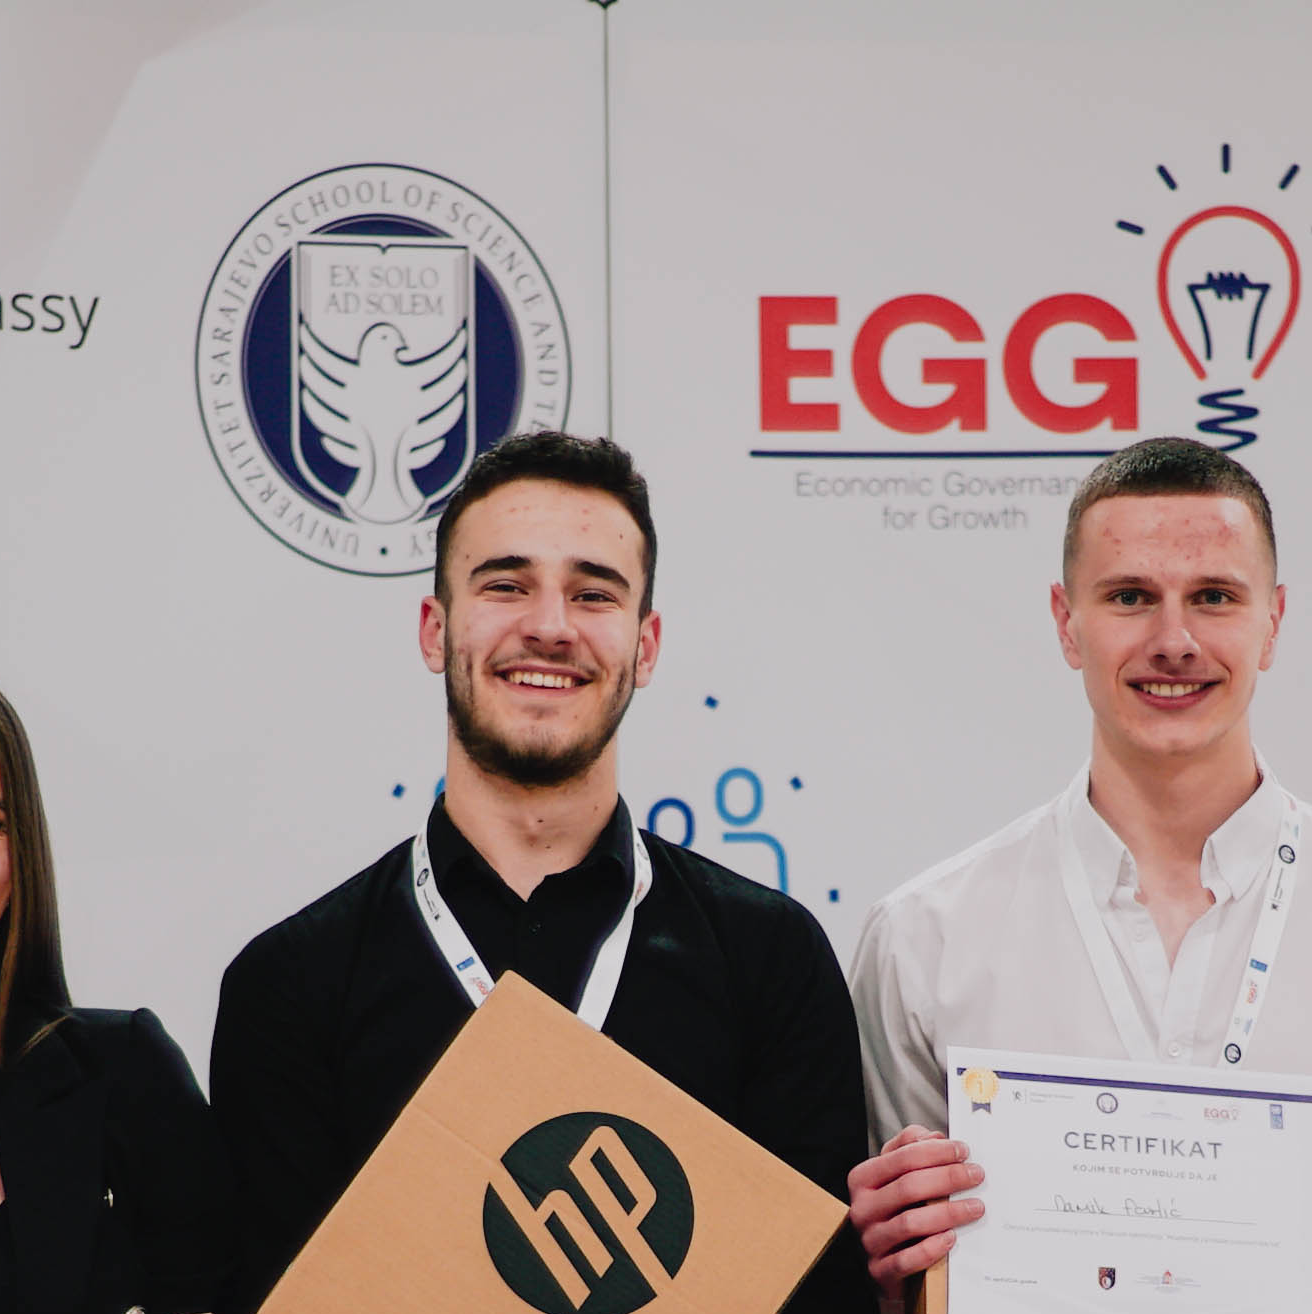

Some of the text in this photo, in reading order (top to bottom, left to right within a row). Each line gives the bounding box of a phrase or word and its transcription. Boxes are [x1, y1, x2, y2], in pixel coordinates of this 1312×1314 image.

[210, 231, 274, 387] SARAJEVO
[274, 179, 393, 238] SCHOOL
[402, 182, 443, 212] OF
[446, 201, 545, 313] SCIENCE
[530, 320, 559, 388] AND
[757, 292, 1140, 435] EGG
[794, 471, 1082, 498] Economic Governan
[881, 503, 1029, 532] for Growth
[1063, 1130, 1224, 1161] CERTIFIKAT
[1072, 1163, 1106, 1174] KOJIM
[486, 1120, 679, 1314] hp
